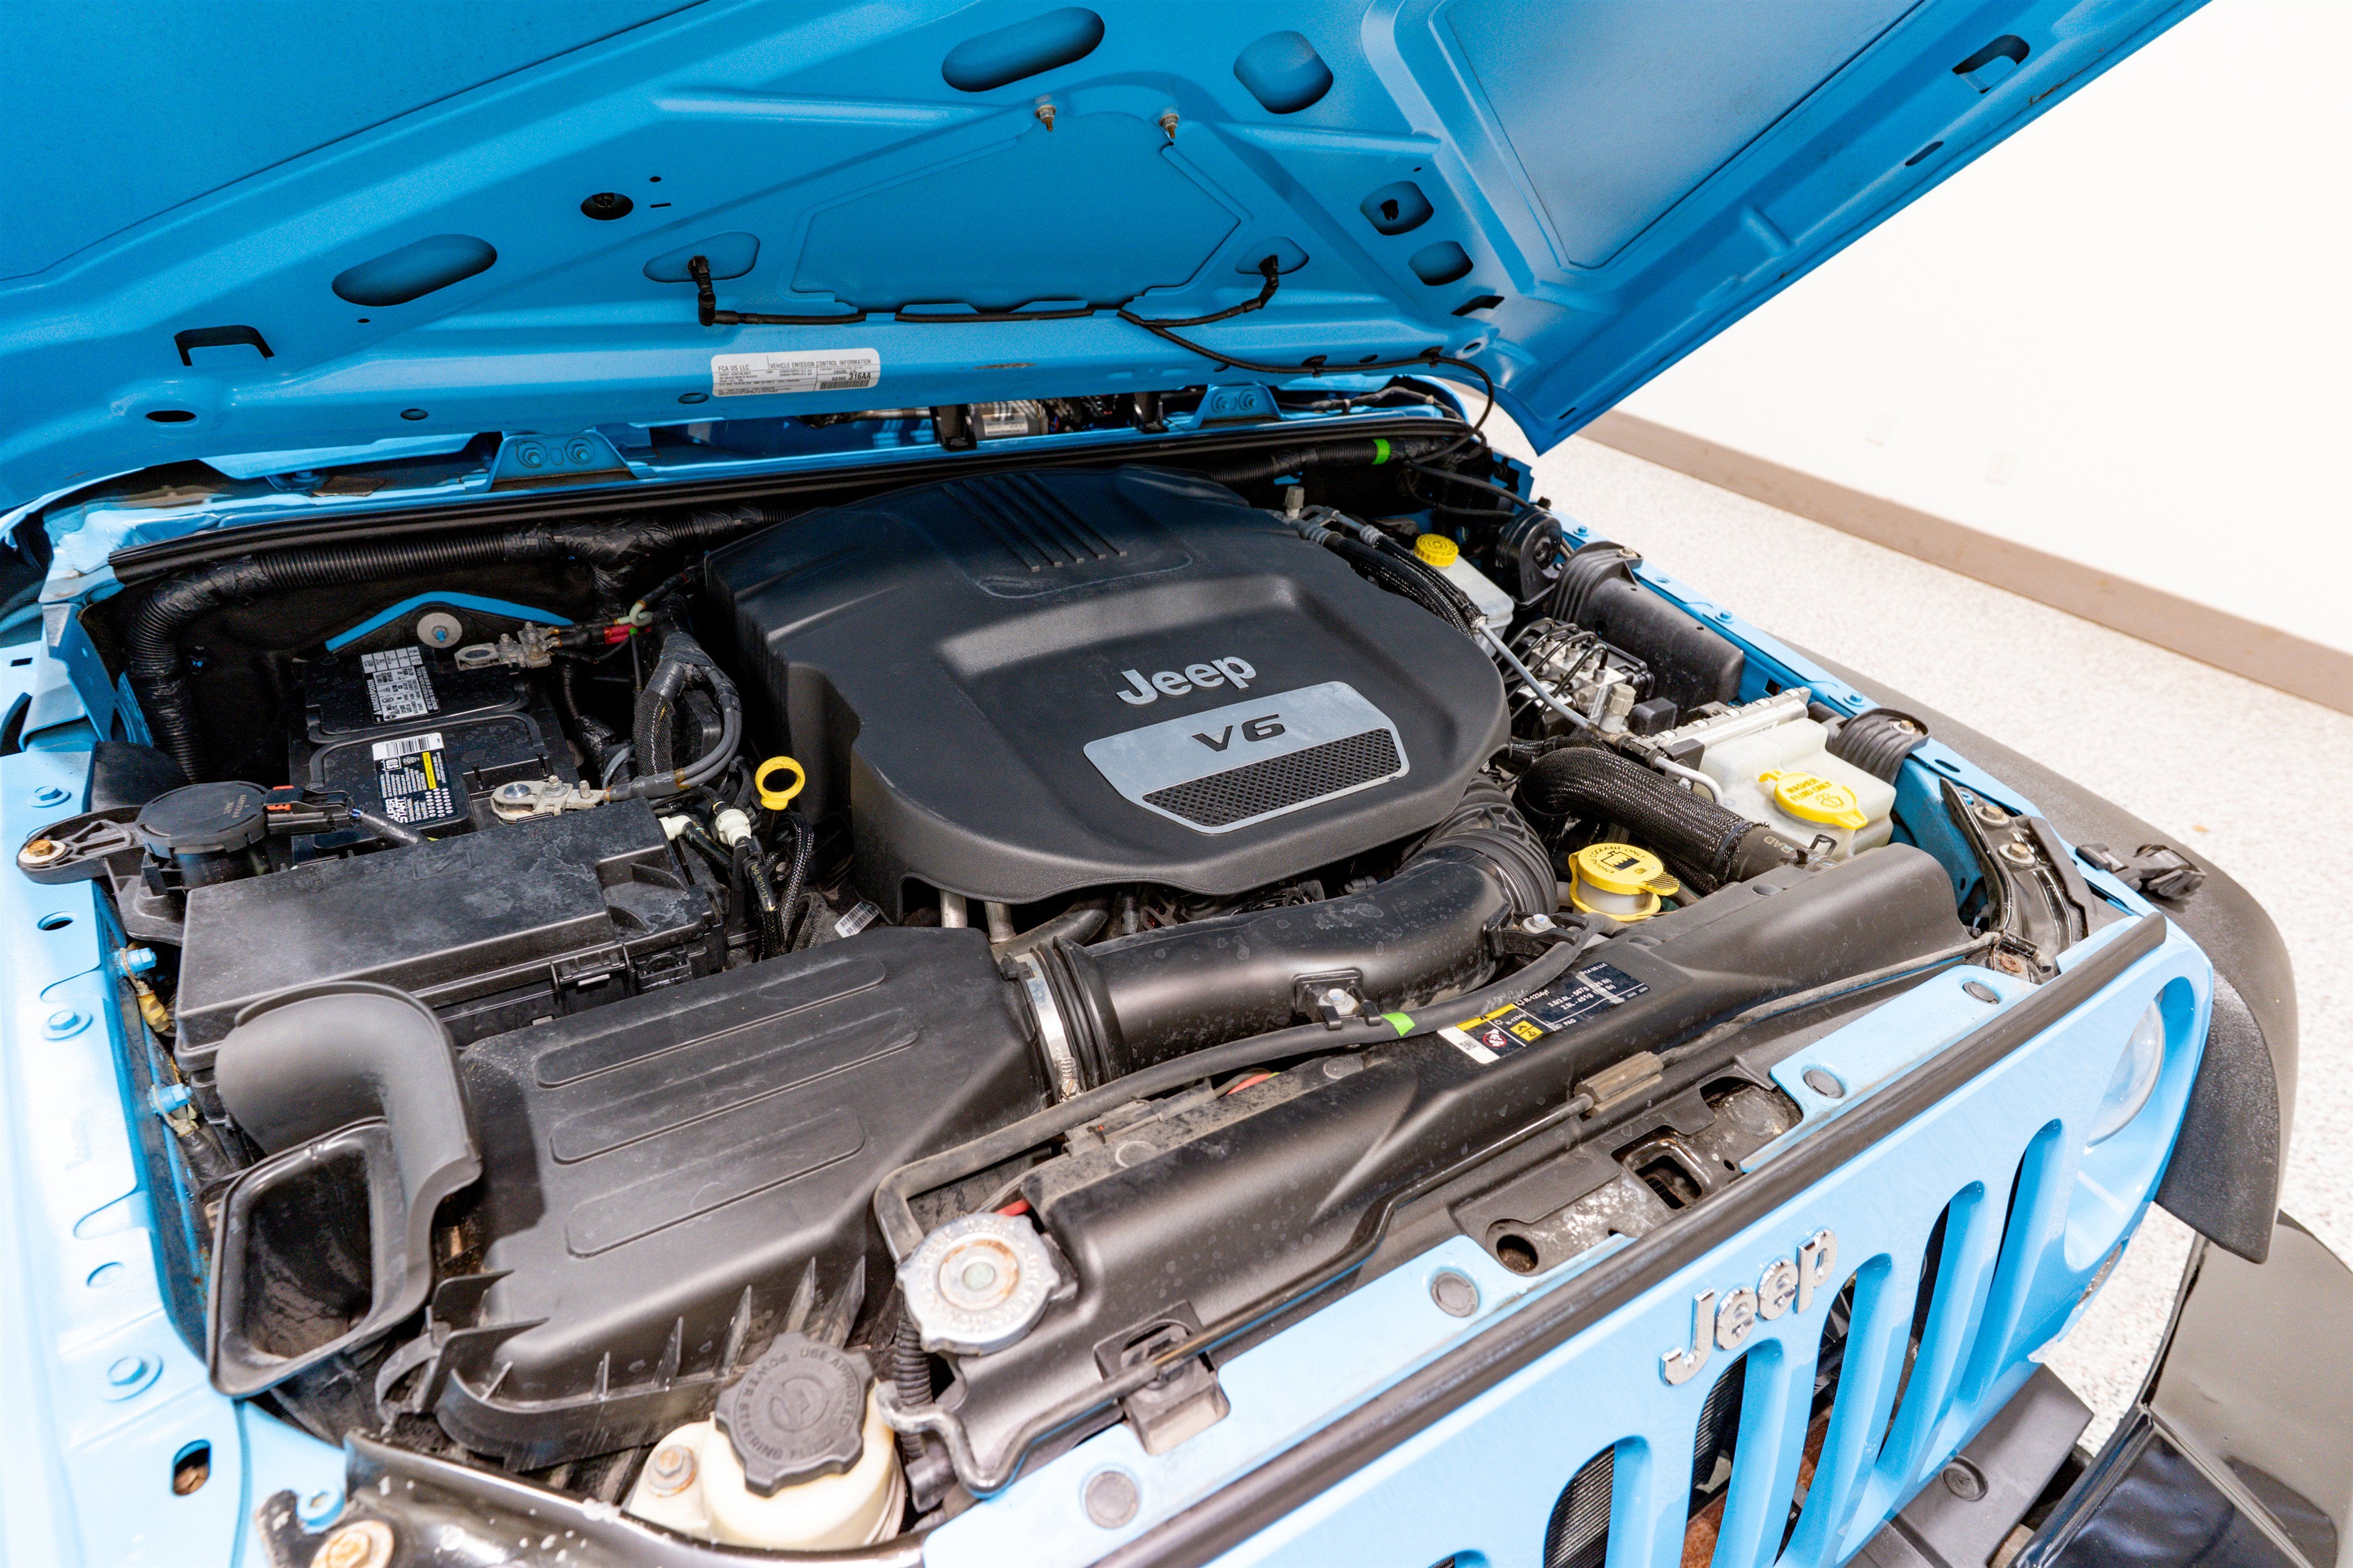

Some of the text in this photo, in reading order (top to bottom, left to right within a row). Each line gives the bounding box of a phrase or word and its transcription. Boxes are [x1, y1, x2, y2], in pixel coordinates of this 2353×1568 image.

[849, 372, 871, 380] 316AA
[1117, 656, 1256, 706] Jeep
[1191, 714, 1286, 752] V6
[385, 758, 399, 770] STD
[1784, 778, 1819, 794] WASHER
[1789, 781, 1833, 802] FLUID ONLY
[394, 797, 408, 824] START
[1764, 835, 1795, 854] RAD
[1590, 846, 1647, 874] ENGINE COOLANT ONLY
[1523, 989, 1550, 1003] R-1234yf
[1547, 995, 1572, 1007] 3.0/3.6L
[1572, 986, 1590, 996] 567g
[1560, 1002, 1576, 1010] 2.8L
[1577, 992, 1594, 1003] 451g
[1505, 1013, 1527, 1025] R-1234yf
[1563, 1018, 1577, 1026] PAG
[1660, 1228, 1838, 1385] Jeep
[742, 1353, 790, 1397] POWER
[799, 1347, 857, 1427] USE APPROVED
[738, 1401, 784, 1460] STEERING
